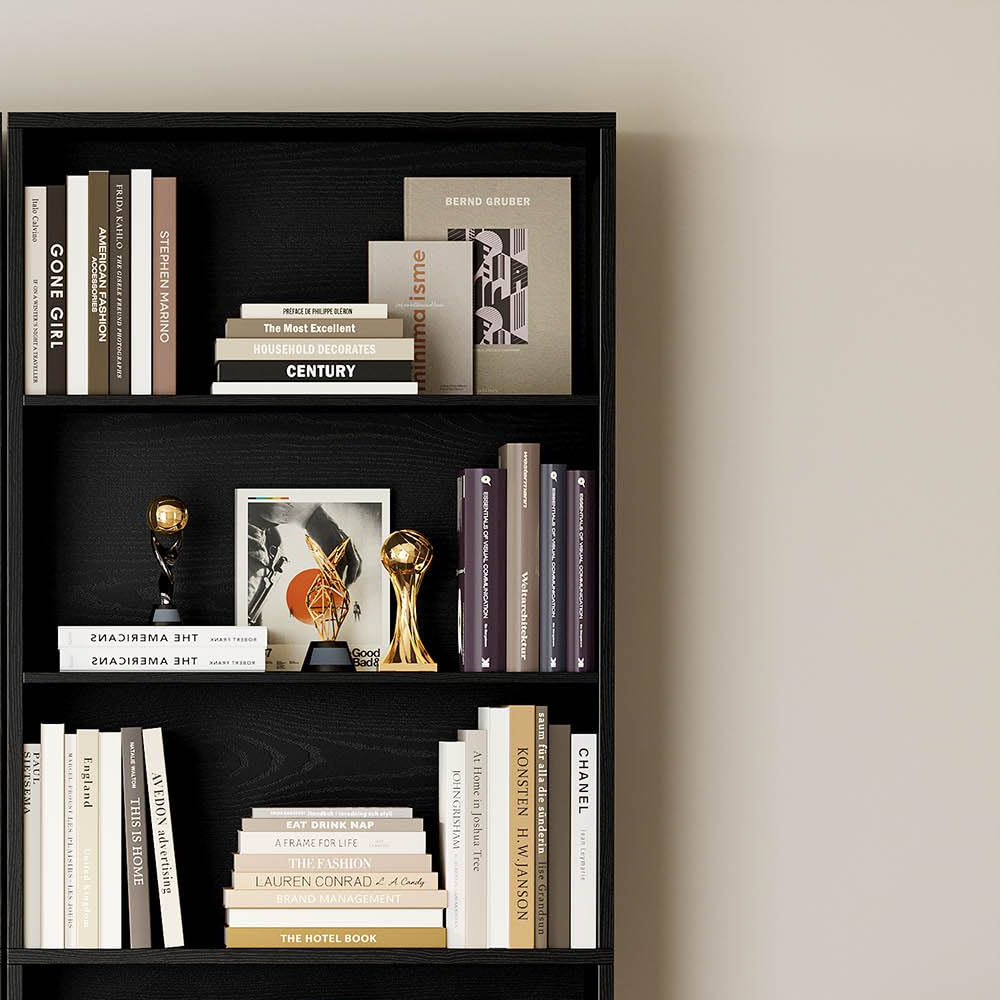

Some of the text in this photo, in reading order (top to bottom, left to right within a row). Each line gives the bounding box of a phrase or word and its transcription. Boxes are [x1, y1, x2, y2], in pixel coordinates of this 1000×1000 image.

[446, 197, 530, 206] BERND GRUBER
[160, 231, 169, 342] STEPHEN MARINO
[51, 244, 63, 348] GONE GIRL
[264, 324, 355, 333] The Most Excellent
[254, 344, 375, 354] HOUSEHOLD DECORATES
[287, 365, 356, 378] CENTURY
[483, 530, 489, 539] OF
[520, 571, 528, 660] Weltarchitektur
[352, 649, 380, 657] Good
[538, 744, 547, 760] für
[538, 764, 547, 783] alla
[579, 748, 588, 813] CHANEL
[82, 758, 92, 807] England
[538, 787, 547, 803] die
[130, 798, 140, 826] THIS
[471, 751, 481, 871] At Home in Joshua Tree
[132, 832, 141, 842] IS
[151, 773, 173, 894] AVEDON advertising
[516, 748, 528, 920] KONSTEN H.W.JANSON
[275, 839, 357, 847] A FRAME FOR LIFE
[132, 847, 143, 885] HOME
[288, 858, 371, 868] THE FASHION
[256, 877, 372, 887] LAUREN CONRAD
[277, 895, 400, 903] BRAND MANAGEMENT
